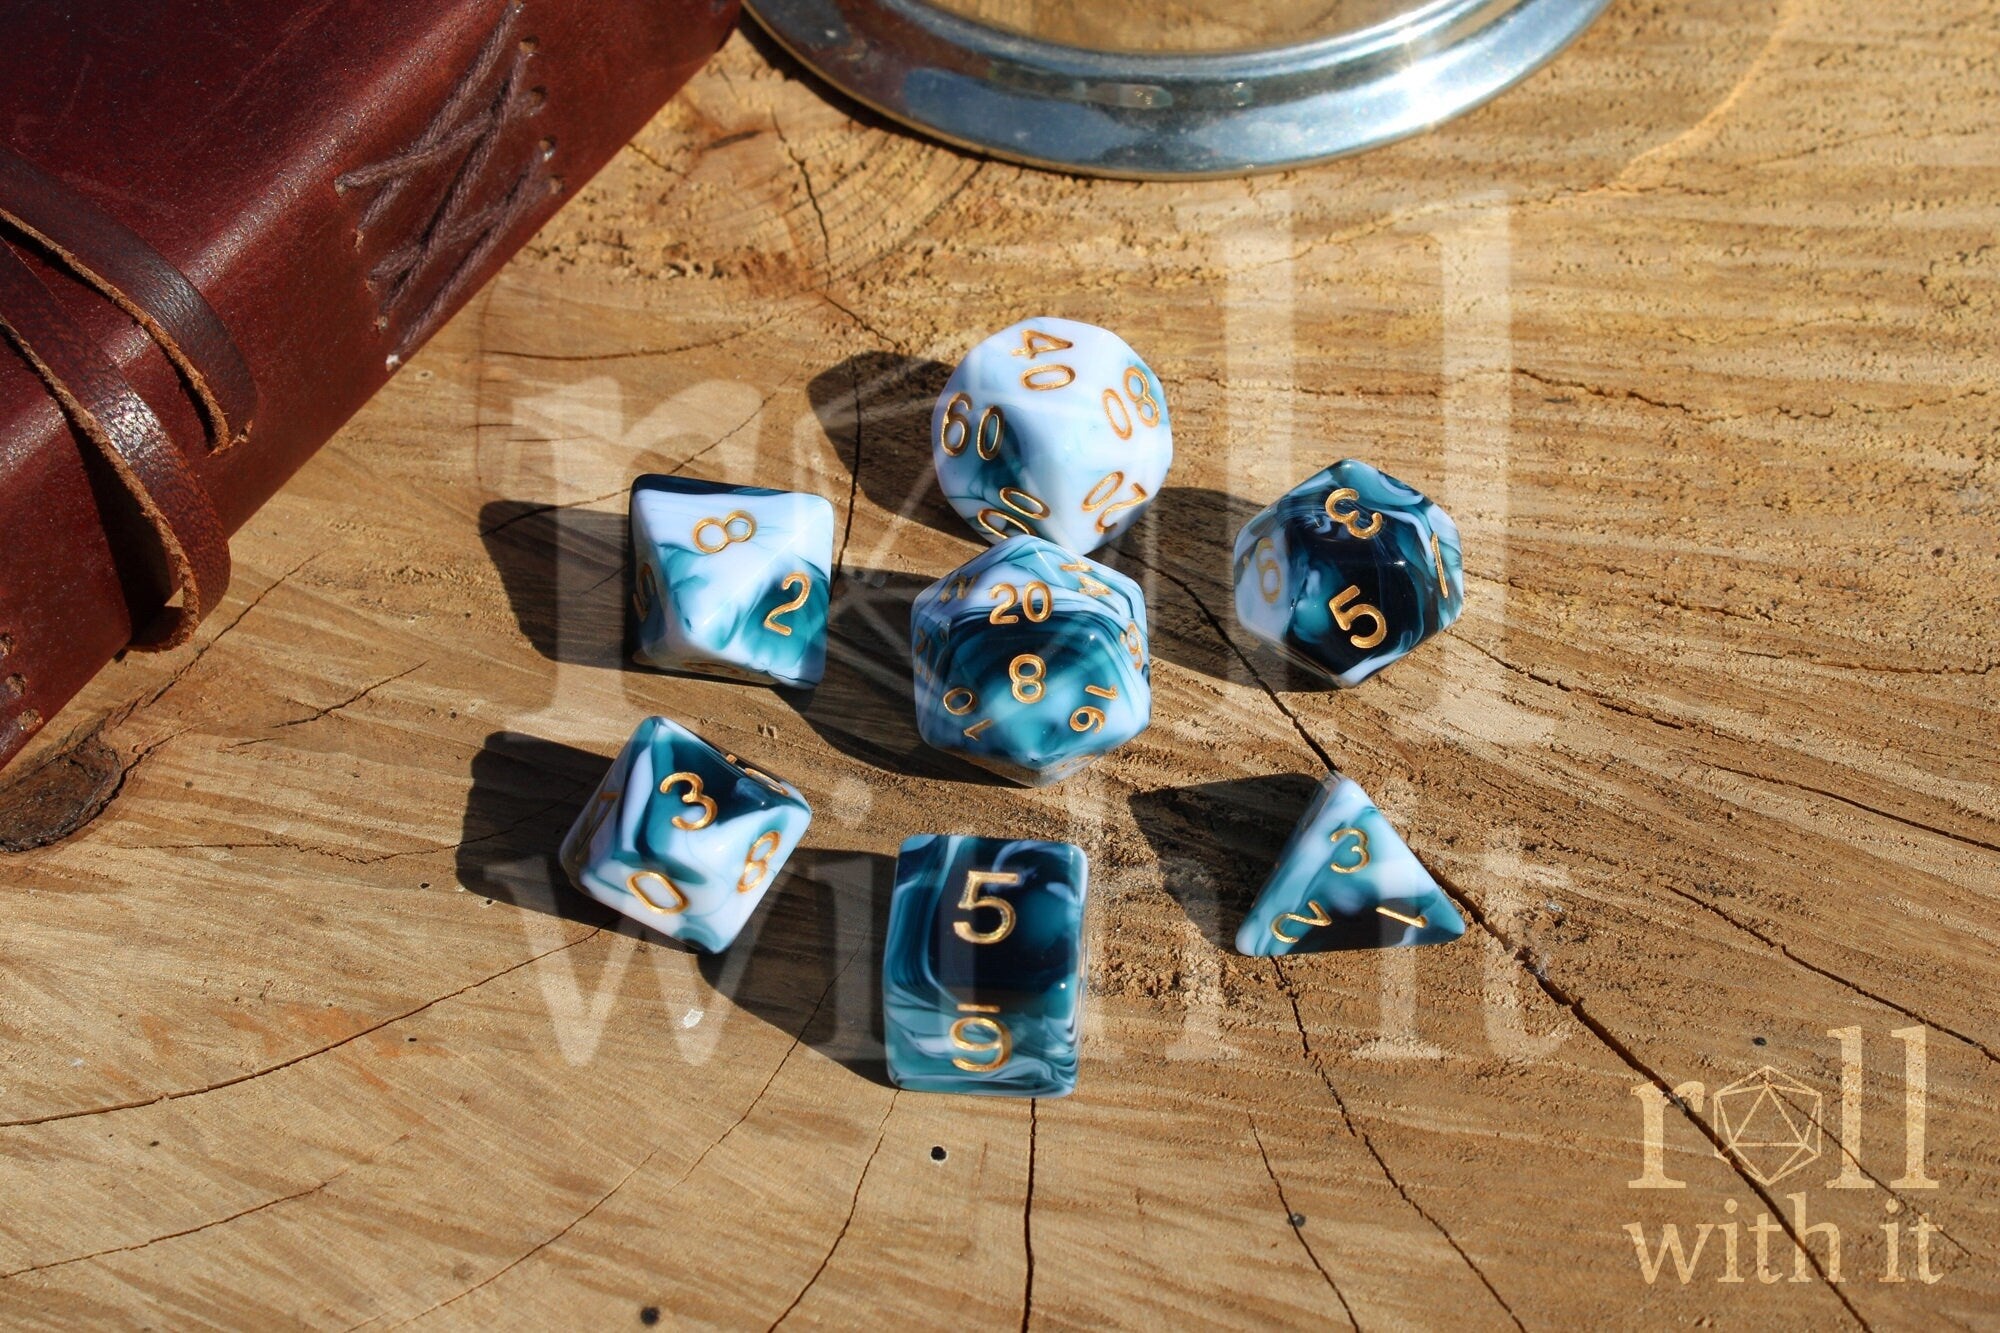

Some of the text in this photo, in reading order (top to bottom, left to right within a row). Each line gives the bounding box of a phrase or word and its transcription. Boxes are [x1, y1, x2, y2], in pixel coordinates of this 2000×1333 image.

[1011, 329, 1075, 391] 40
[941, 392, 1003, 461] 60
[1101, 366, 1160, 440] 80
[1082, 471, 1148, 534] 20
[1325, 488, 1382, 539] 3
[692, 510, 757, 554] 8
[763, 572, 811, 636] 2
[989, 581, 1053, 625] 20
[1329, 585, 1387, 649] 5
[1008, 653, 1047, 704] 8
[1069, 684, 1118, 733] 16
[659, 771, 718, 831] 3
[736, 831, 781, 894] 8
[1329, 828, 1371, 874] 3
[626, 871, 690, 914] 0
[953, 871, 1020, 945] 5
[1375, 906, 1430, 929] 1
[1270, 899, 1332, 943] 2
